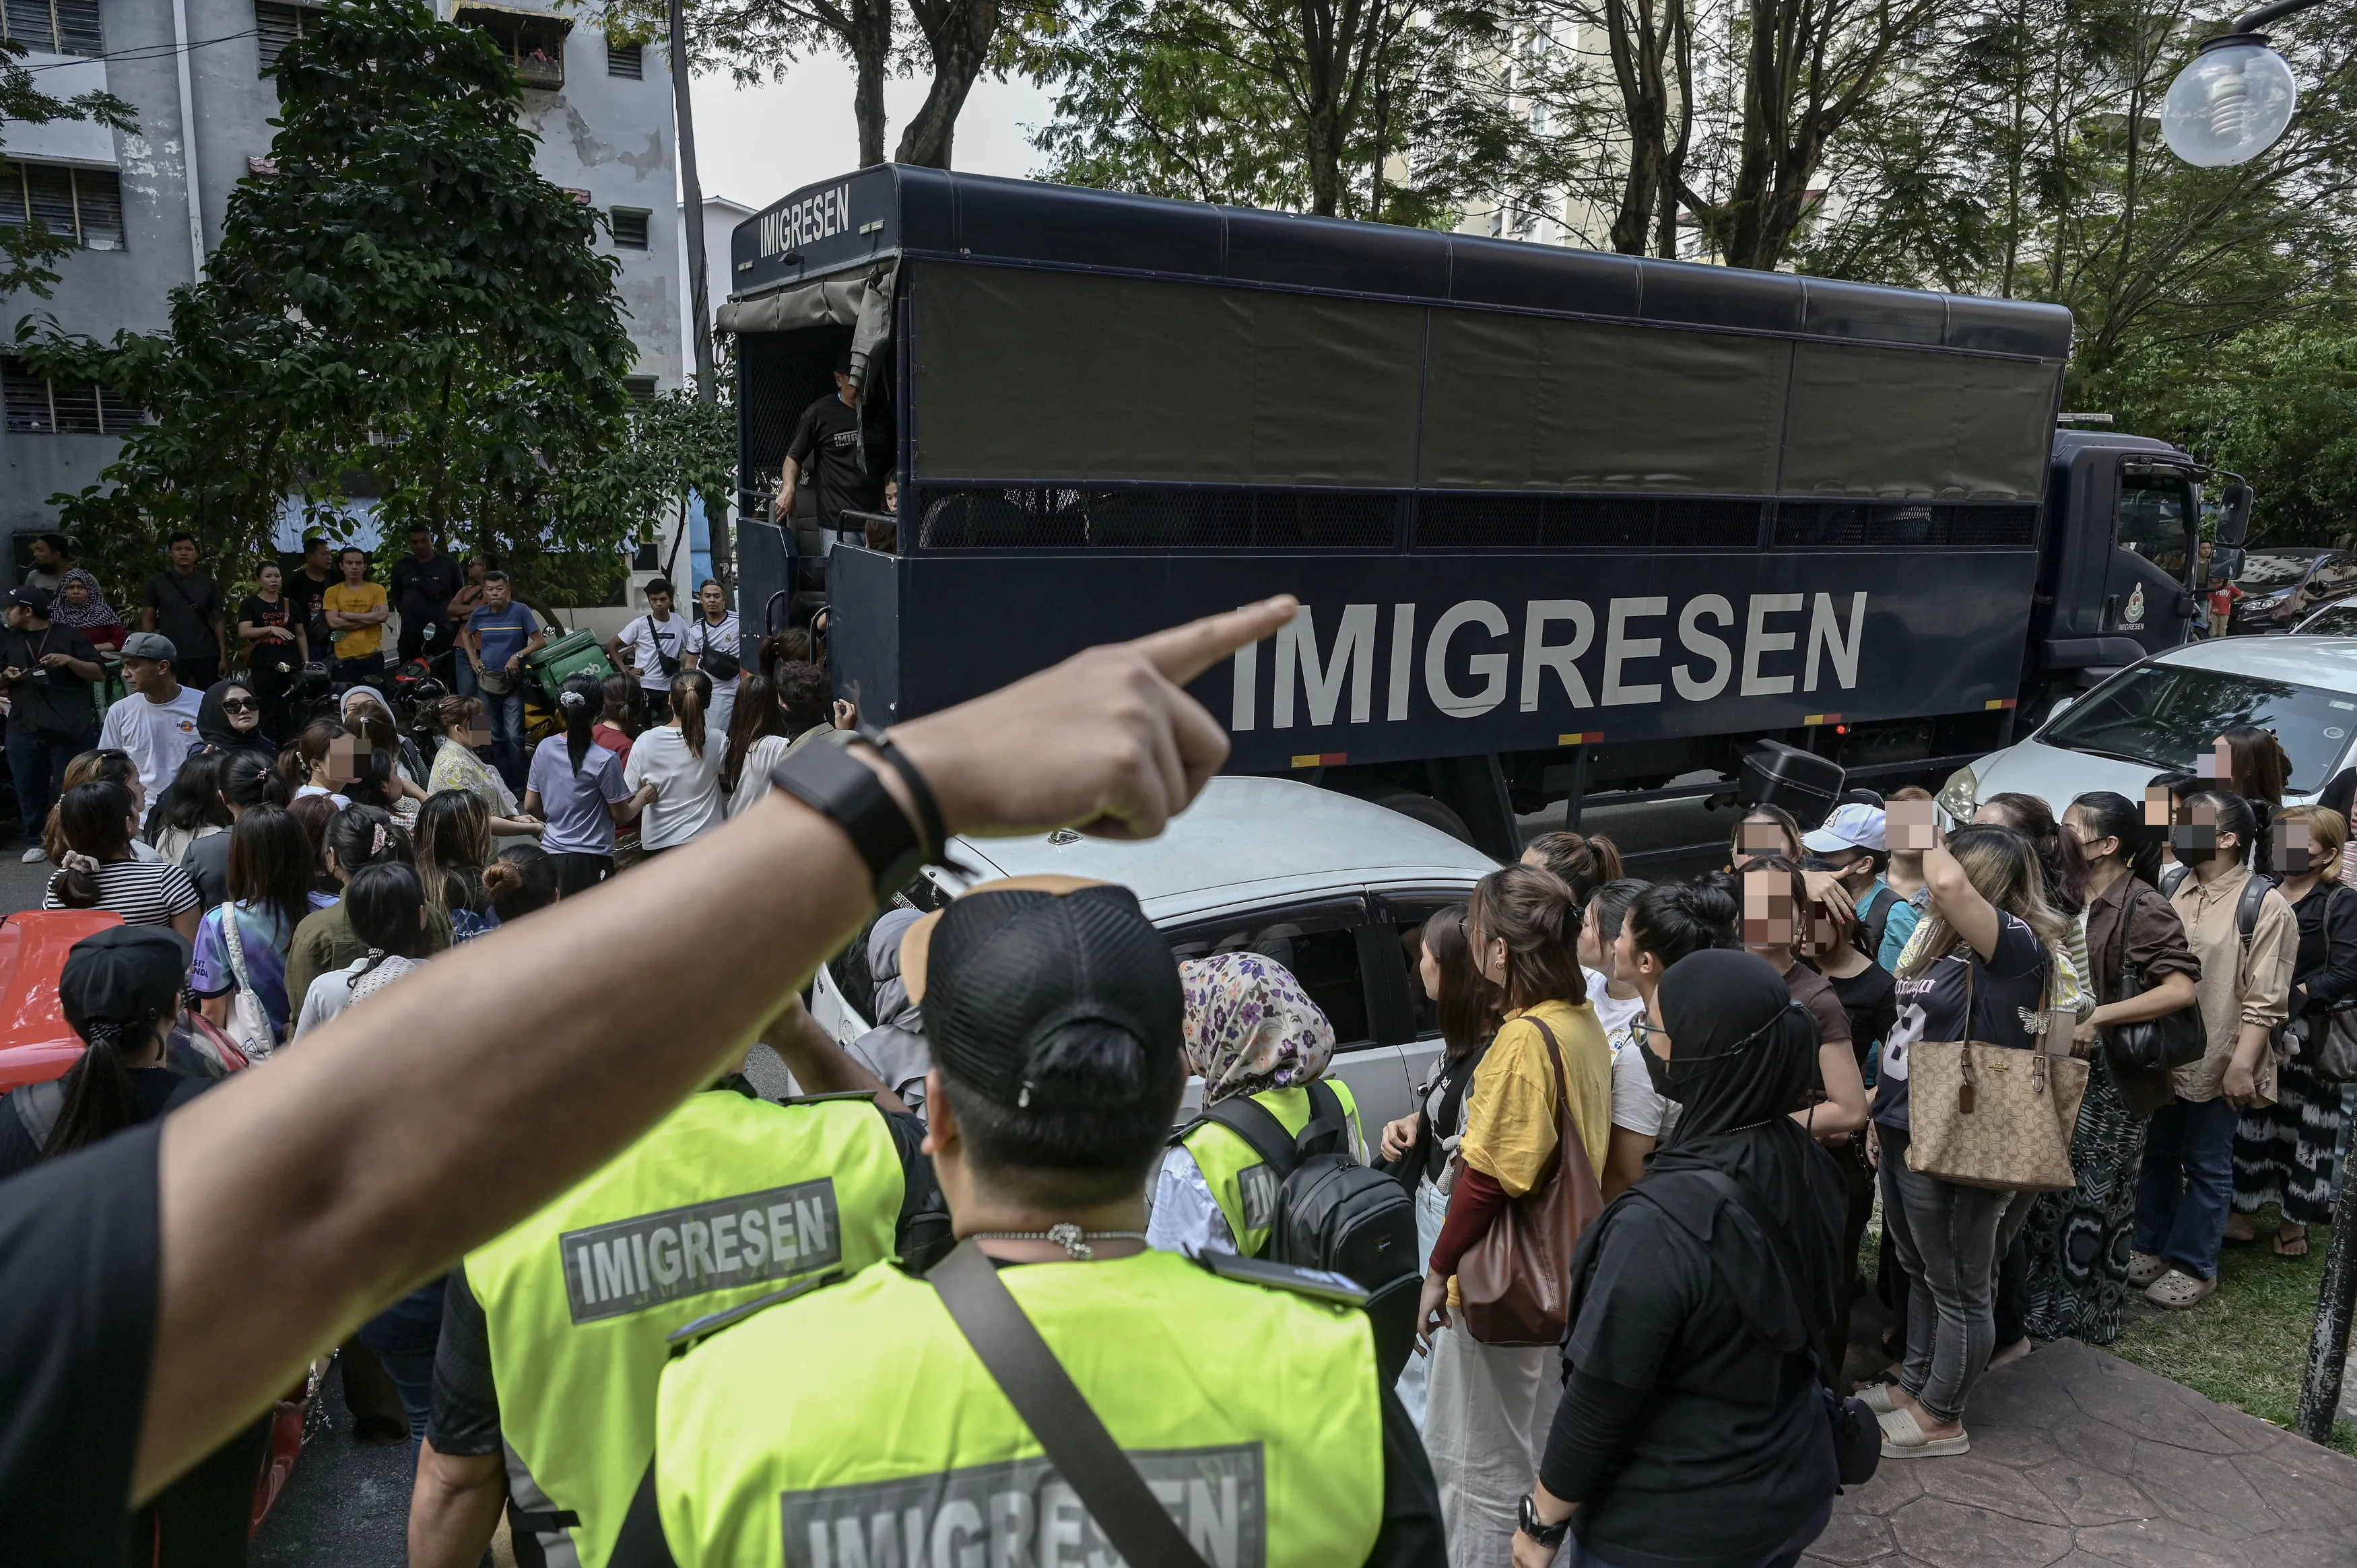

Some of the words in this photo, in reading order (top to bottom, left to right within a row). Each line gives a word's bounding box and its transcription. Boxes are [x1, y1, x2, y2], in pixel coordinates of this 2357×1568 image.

[760, 183, 849, 258] IMIGRESEN
[1232, 590, 1867, 732] IMIGRESEN
[1824, 809, 1841, 828] A
[193, 959, 205, 968] SIT
[577, 1196, 828, 1305] IMIGRESEN
